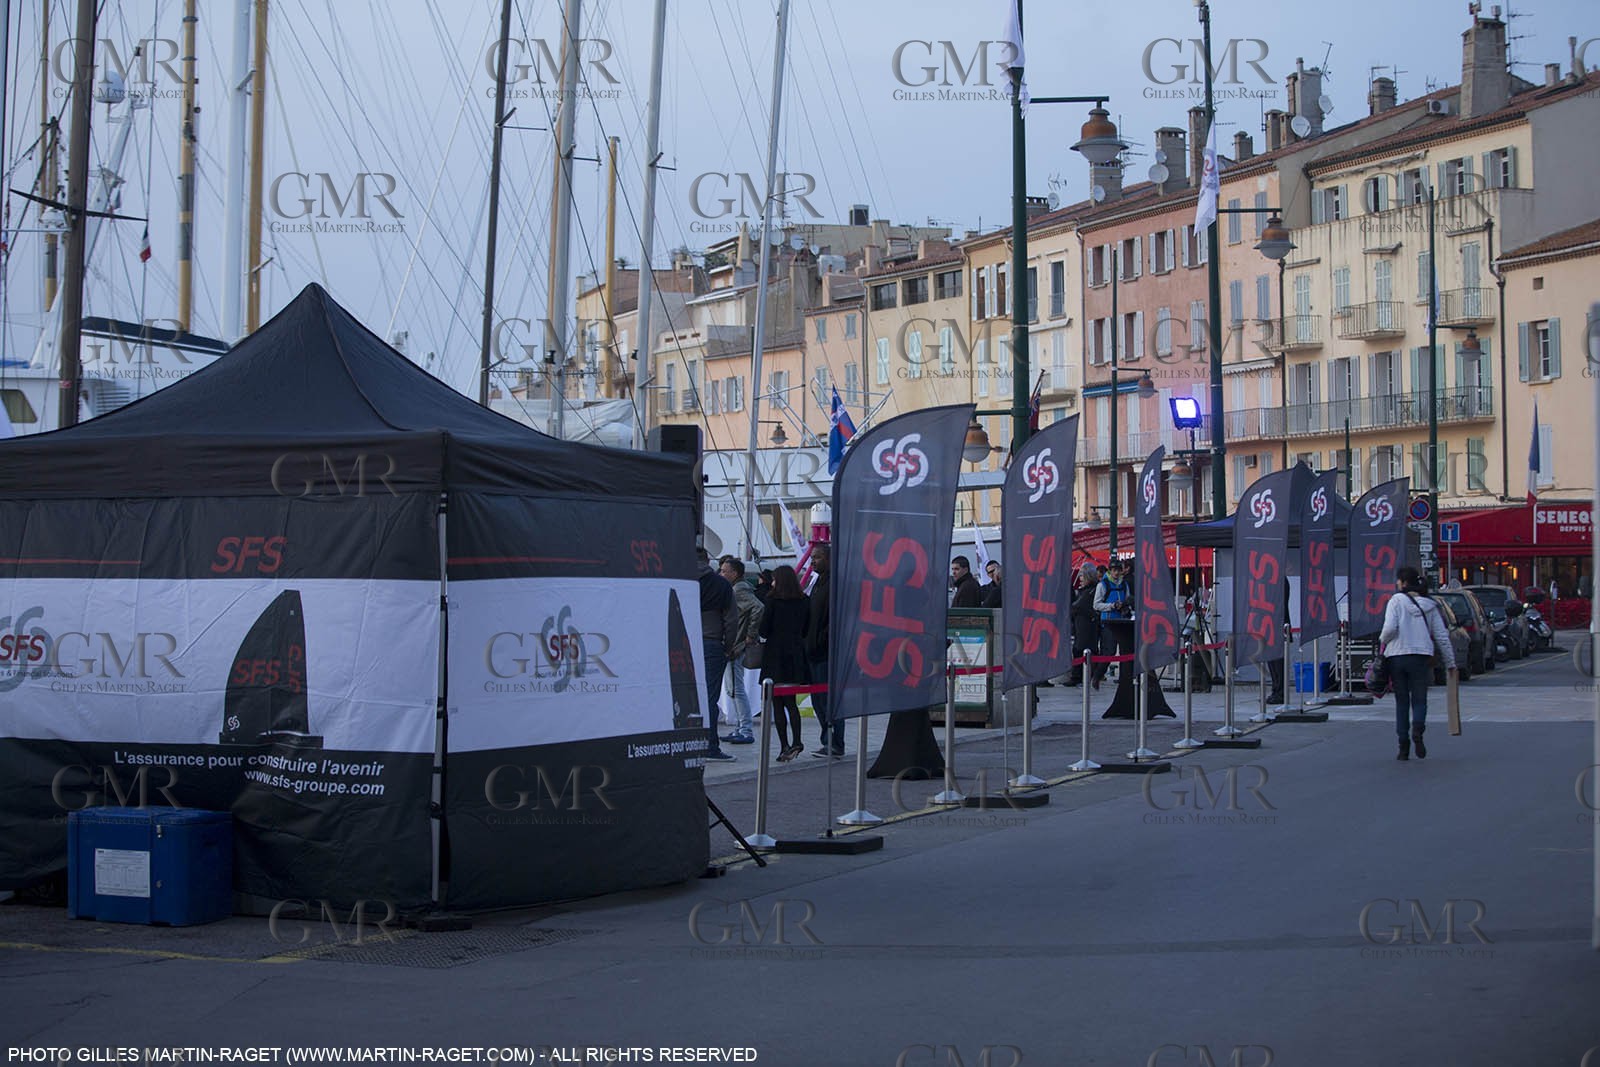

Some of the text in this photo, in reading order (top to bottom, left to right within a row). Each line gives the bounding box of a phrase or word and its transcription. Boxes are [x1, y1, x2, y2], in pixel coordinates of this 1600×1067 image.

[1536, 510, 1595, 524] SENEQ
[211, 536, 287, 573] SFS
[1142, 540, 1174, 647] SFS
[1308, 541, 1328, 622] SFS
[1364, 543, 1396, 615] SFS
[855, 531, 928, 688] SFS
[1022, 534, 1059, 659] SFS
[1248, 550, 1279, 647] SFS
[0, 634, 45, 661] SFS
[549, 634, 579, 661] SFS
[233, 659, 281, 686] SFS
[114, 751, 385, 777] L'assurance pour construire l'avenir
[627, 742, 670, 758] L'assurance
[671, 741, 684, 756] pour
[244, 769, 385, 795] www.sfs-groupe.com
